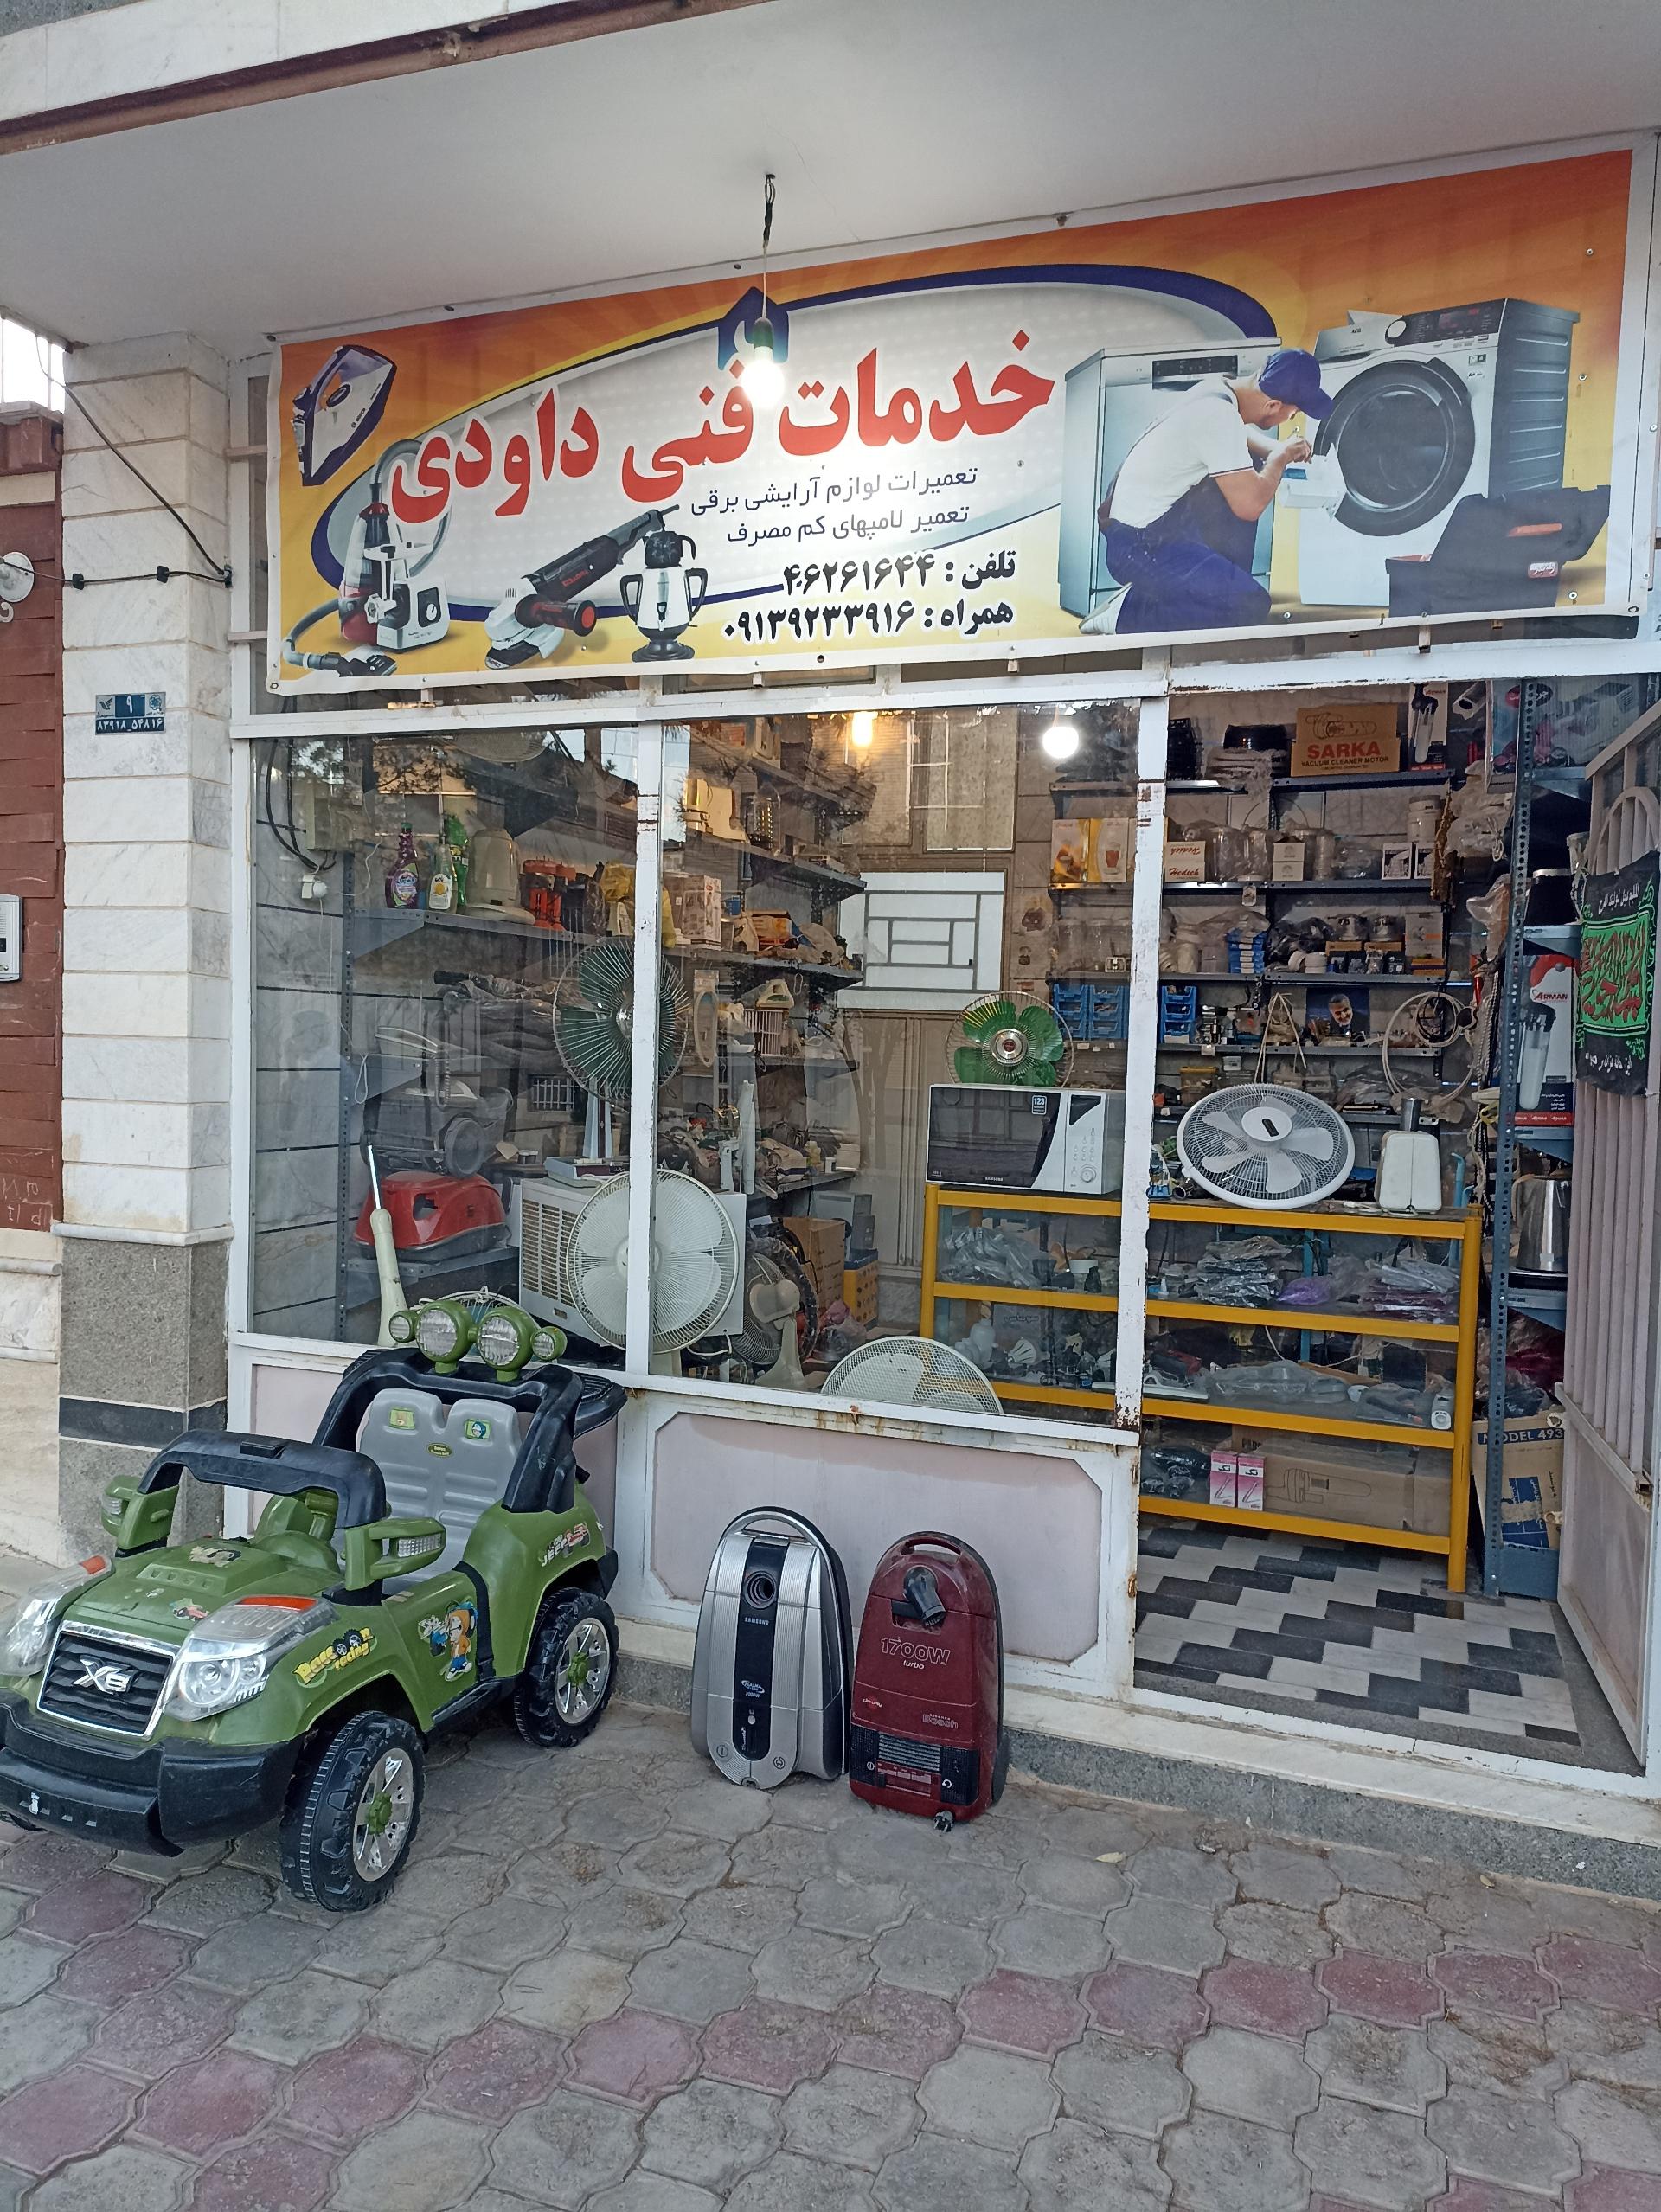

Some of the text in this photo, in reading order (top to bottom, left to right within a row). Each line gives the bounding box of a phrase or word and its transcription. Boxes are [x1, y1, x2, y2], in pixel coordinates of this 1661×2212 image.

[392, 330, 1055, 523] خدمات فنی داودی
[691, 468, 978, 516] تعمیرات لوازم آرایشی برقی
[798, 516, 825, 542] کم
[911, 506, 970, 533] تعمیر
[728, 523, 792, 546] مصرف
[784, 553, 936, 596] ۴۶۲۶۱۶۴۴
[724, 600, 915, 642] ۰۹۱۳۹۲۳۳۹۱۶
[126, 696, 132, 713] ۹
[1301, 759, 1329, 767] VACUUM
[1331, 757, 1363, 766] CLEANER
[1364, 755, 1389, 764] MOTOR
[1307, 741, 1382, 760] SARKA
[1534, 991, 1568, 1000] ARMAN
[1034, 1097, 1045, 1106] 123
[744, 1617, 770, 1626] SAMSUNG
[881, 1637, 951, 1666] 1700W
[902, 1659, 925, 1670] turbo
